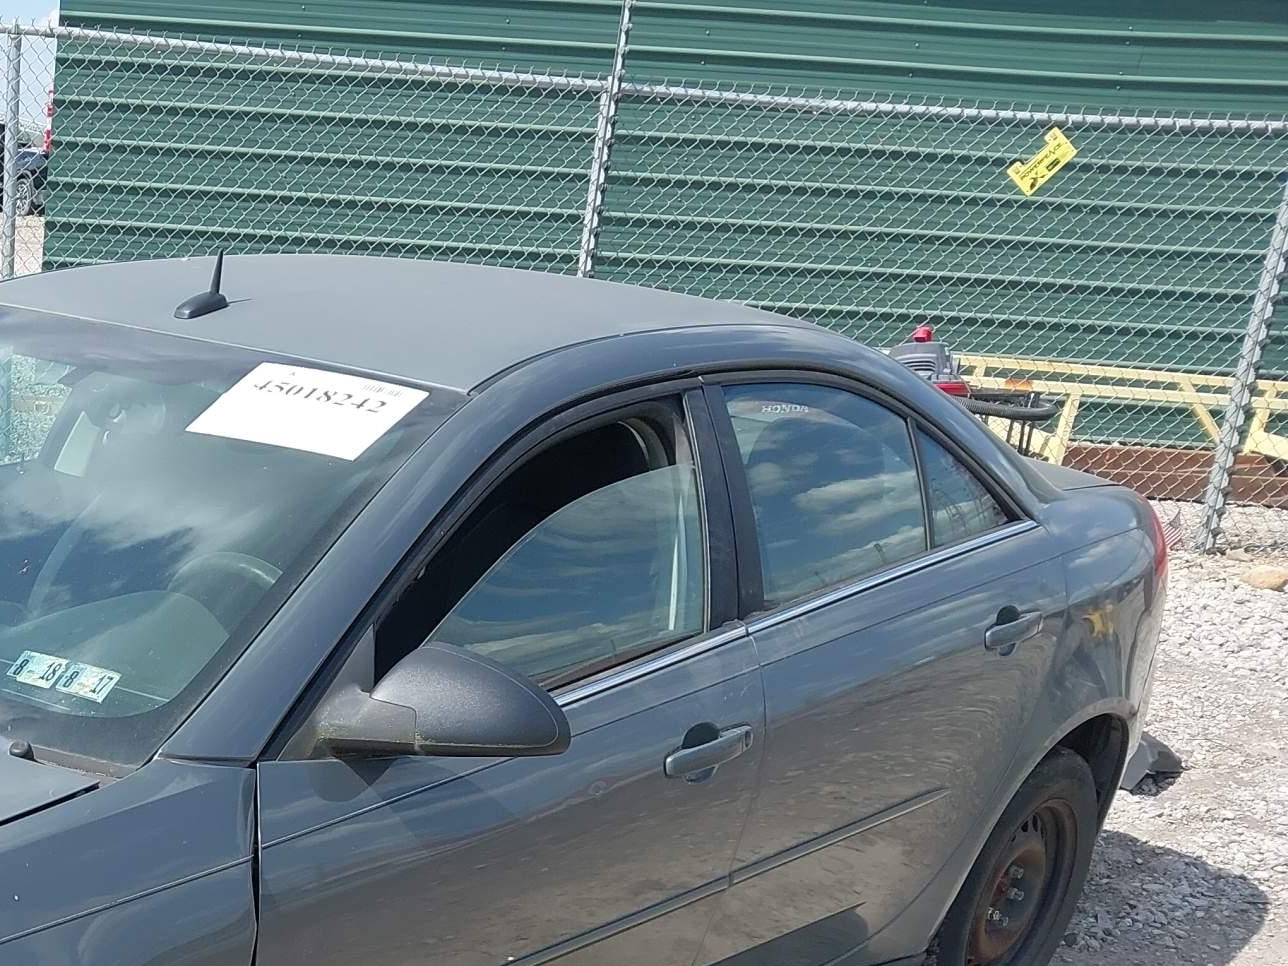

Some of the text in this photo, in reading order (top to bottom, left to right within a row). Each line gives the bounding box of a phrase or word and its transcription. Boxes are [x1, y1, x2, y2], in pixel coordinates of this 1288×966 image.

[254, 380, 387, 413] 45018242
[13, 658, 62, 681] 8 18
[63, 670, 114, 694] 8 17
